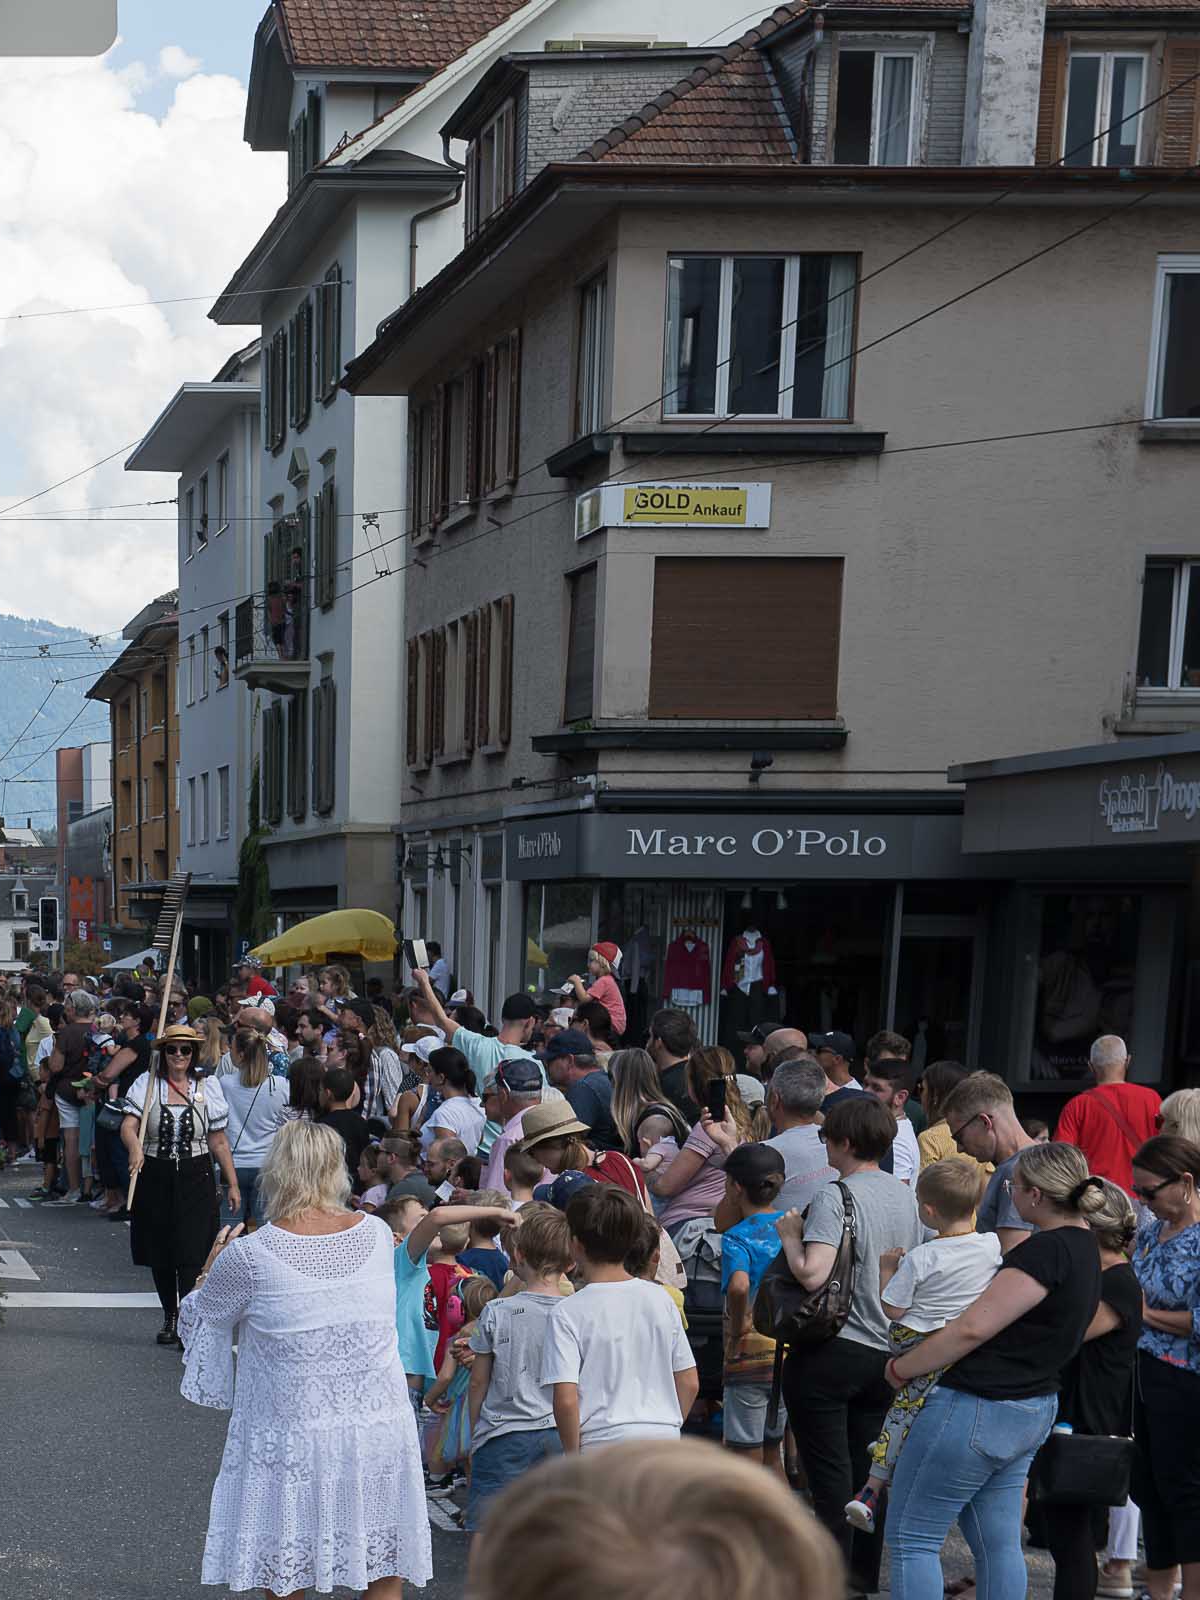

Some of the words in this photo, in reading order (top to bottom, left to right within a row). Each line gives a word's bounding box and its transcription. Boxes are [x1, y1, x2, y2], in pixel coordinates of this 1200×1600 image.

[635, 492, 690, 510] GOLD
[692, 504, 743, 516] Ankauf
[626, 828, 737, 856] Marc
[751, 828, 887, 857] O'Polo
